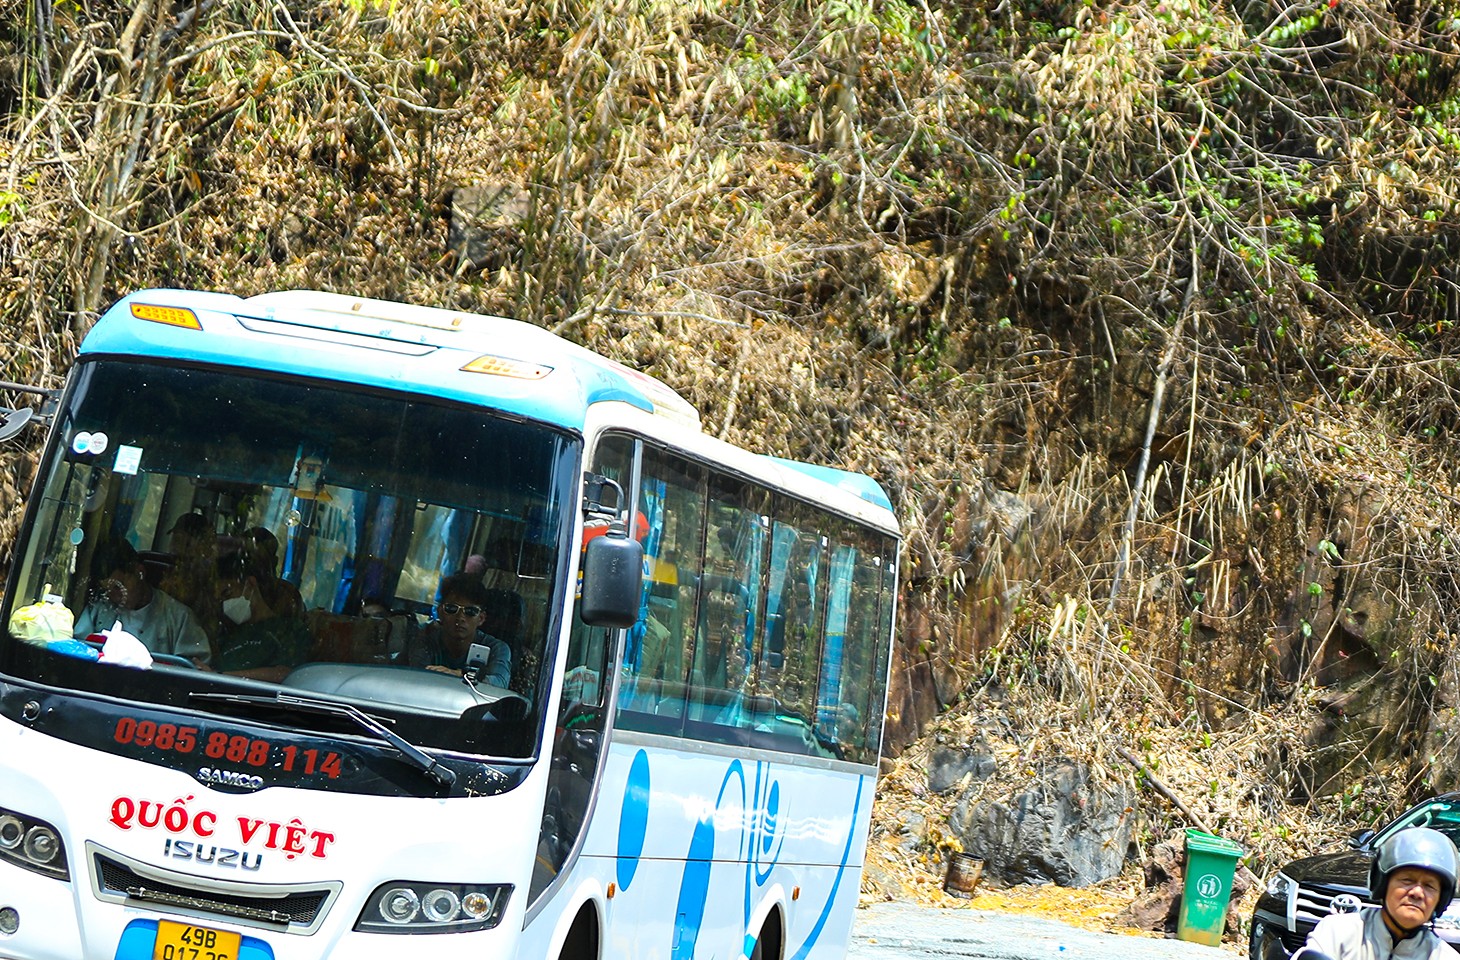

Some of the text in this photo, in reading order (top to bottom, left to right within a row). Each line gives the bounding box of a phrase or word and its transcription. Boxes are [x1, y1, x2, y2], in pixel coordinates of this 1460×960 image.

[114, 717, 342, 779] 0985 888 114
[198, 767, 264, 789] SAMCO
[109, 795, 335, 860] QUỐC VIỆT
[164, 838, 263, 872] ISUZU
[181, 926, 217, 949] 49B
